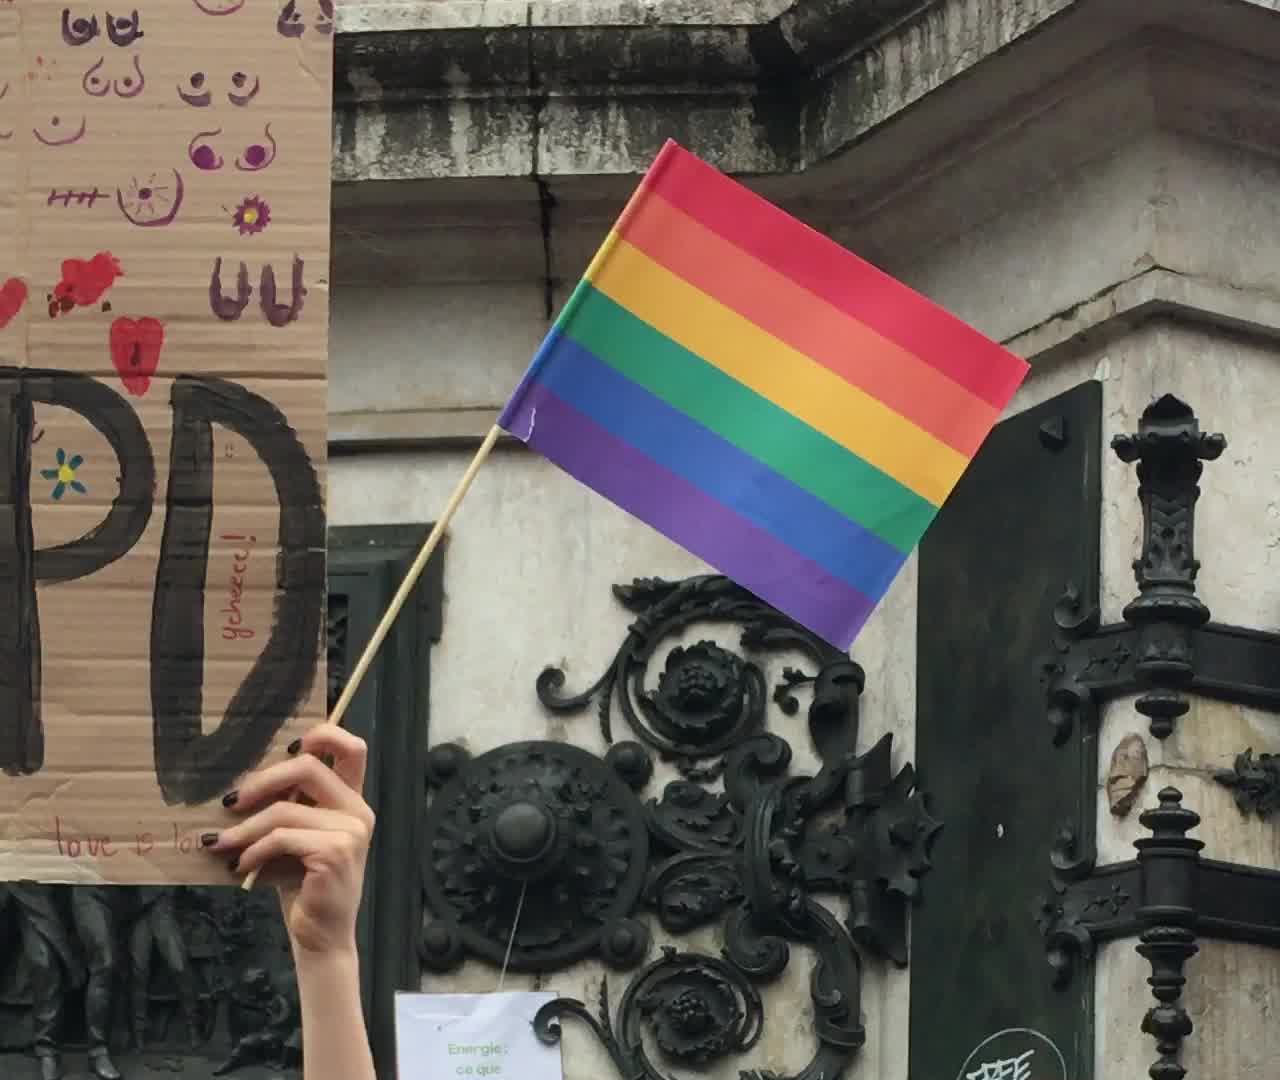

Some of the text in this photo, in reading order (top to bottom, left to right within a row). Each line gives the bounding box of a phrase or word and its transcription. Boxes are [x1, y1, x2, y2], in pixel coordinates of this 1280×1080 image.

[55, 815, 119, 858] love
[135, 820, 154, 856] is
[455, 1065, 502, 1077] ce que
